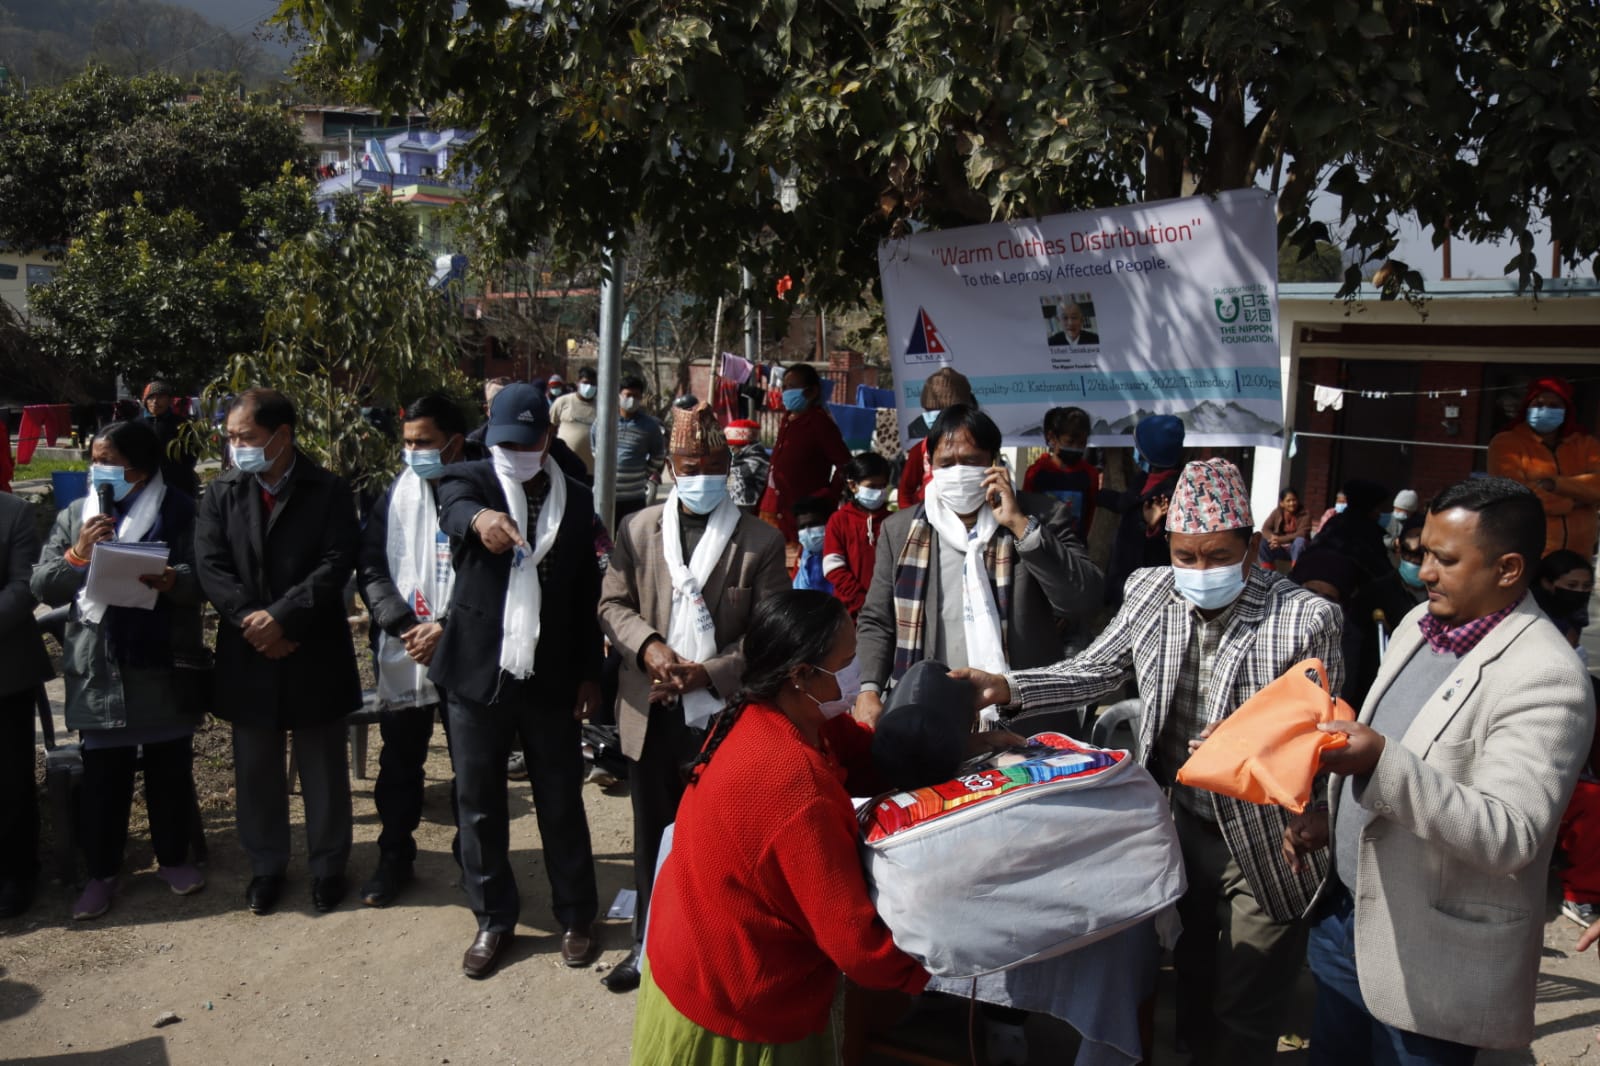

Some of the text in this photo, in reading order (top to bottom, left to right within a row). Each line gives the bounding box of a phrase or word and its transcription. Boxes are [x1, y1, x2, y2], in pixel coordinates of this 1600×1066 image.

[997, 236, 1066, 260] Clothes
[1070, 217, 1201, 253] Distribution"
[962, 256, 1171, 287] To the Leprosy Affected People.
[1220, 324, 1272, 335] THE NIPPON
[1221, 334, 1273, 345] FOUNDATION
